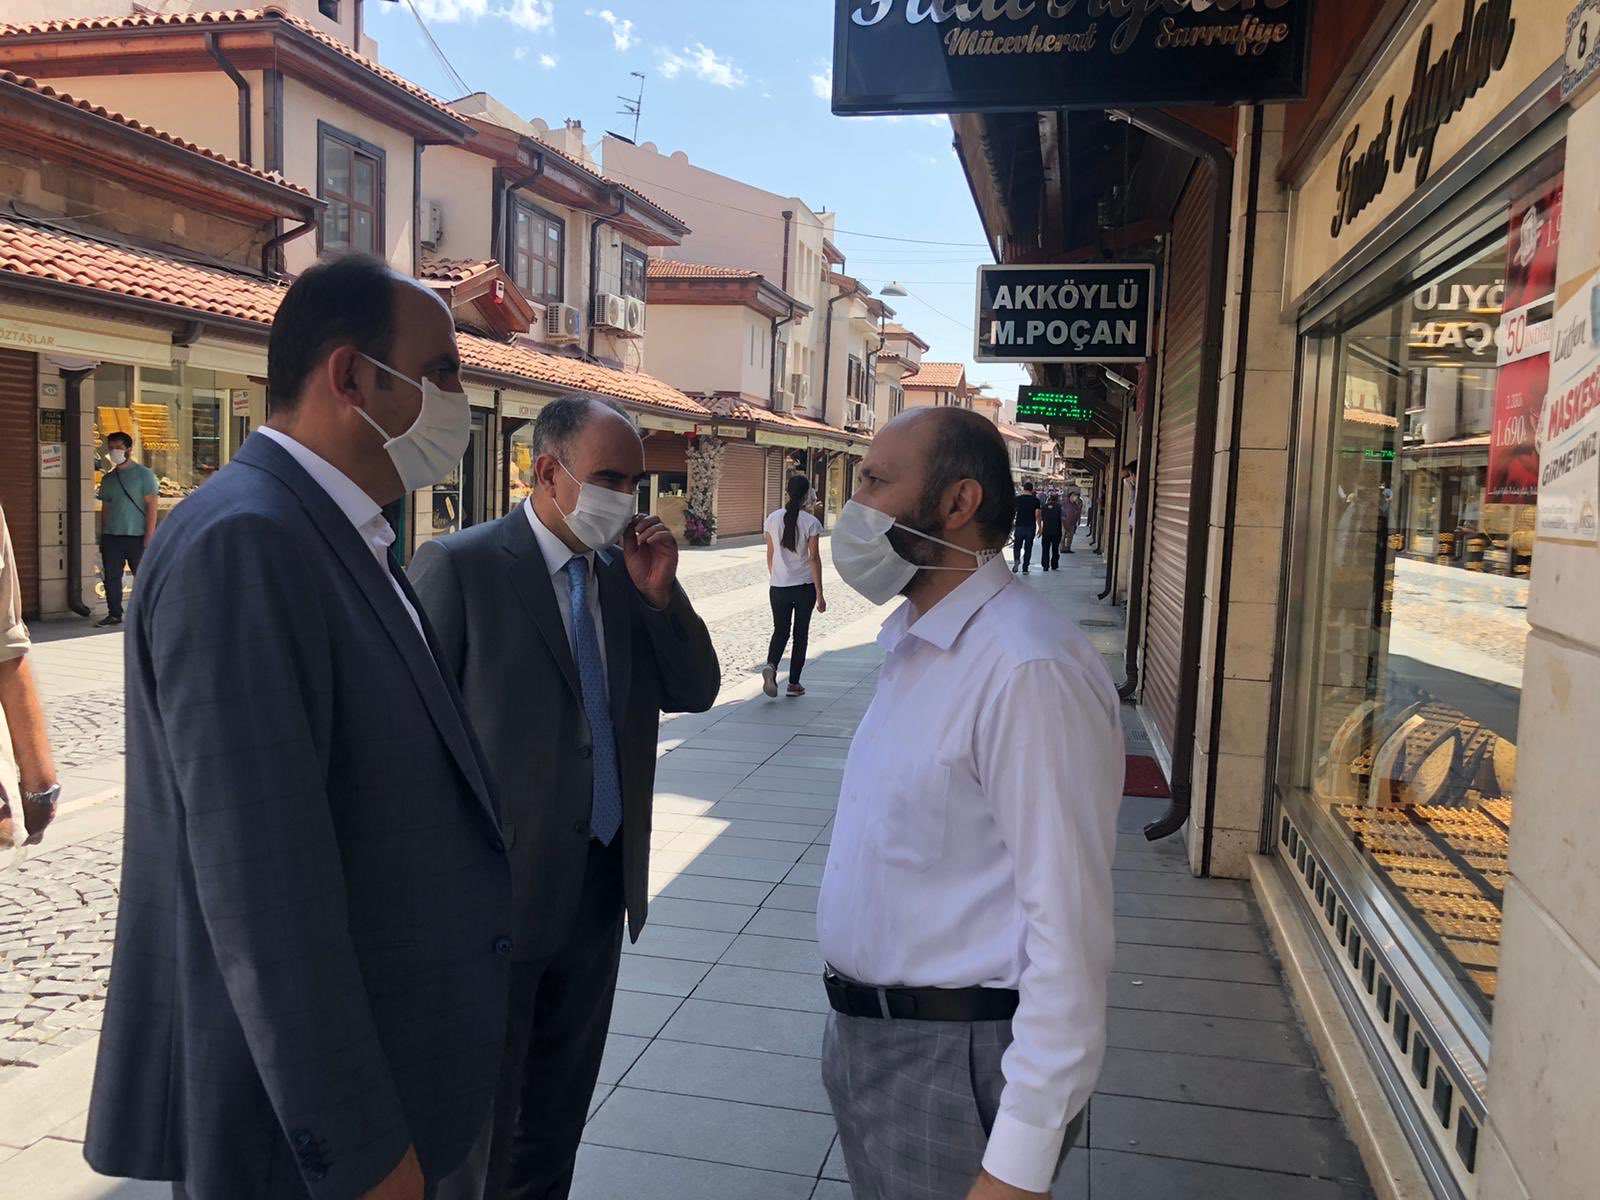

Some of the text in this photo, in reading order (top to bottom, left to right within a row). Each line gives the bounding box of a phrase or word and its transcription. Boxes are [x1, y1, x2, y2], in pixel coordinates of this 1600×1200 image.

[944, 14, 1289, 56] Mücevherat Sarrafiye
[1577, 21, 1588, 60] 8
[992, 278, 1139, 310] AKKÖYLÜ
[990, 319, 1138, 351] M.POÇAN
[1506, 314, 1526, 357] 50
[1554, 314, 1586, 363] Lütfen
[1547, 365, 1600, 442] MASKESİ
[1542, 431, 1597, 487] GİRMEYİNİZ
